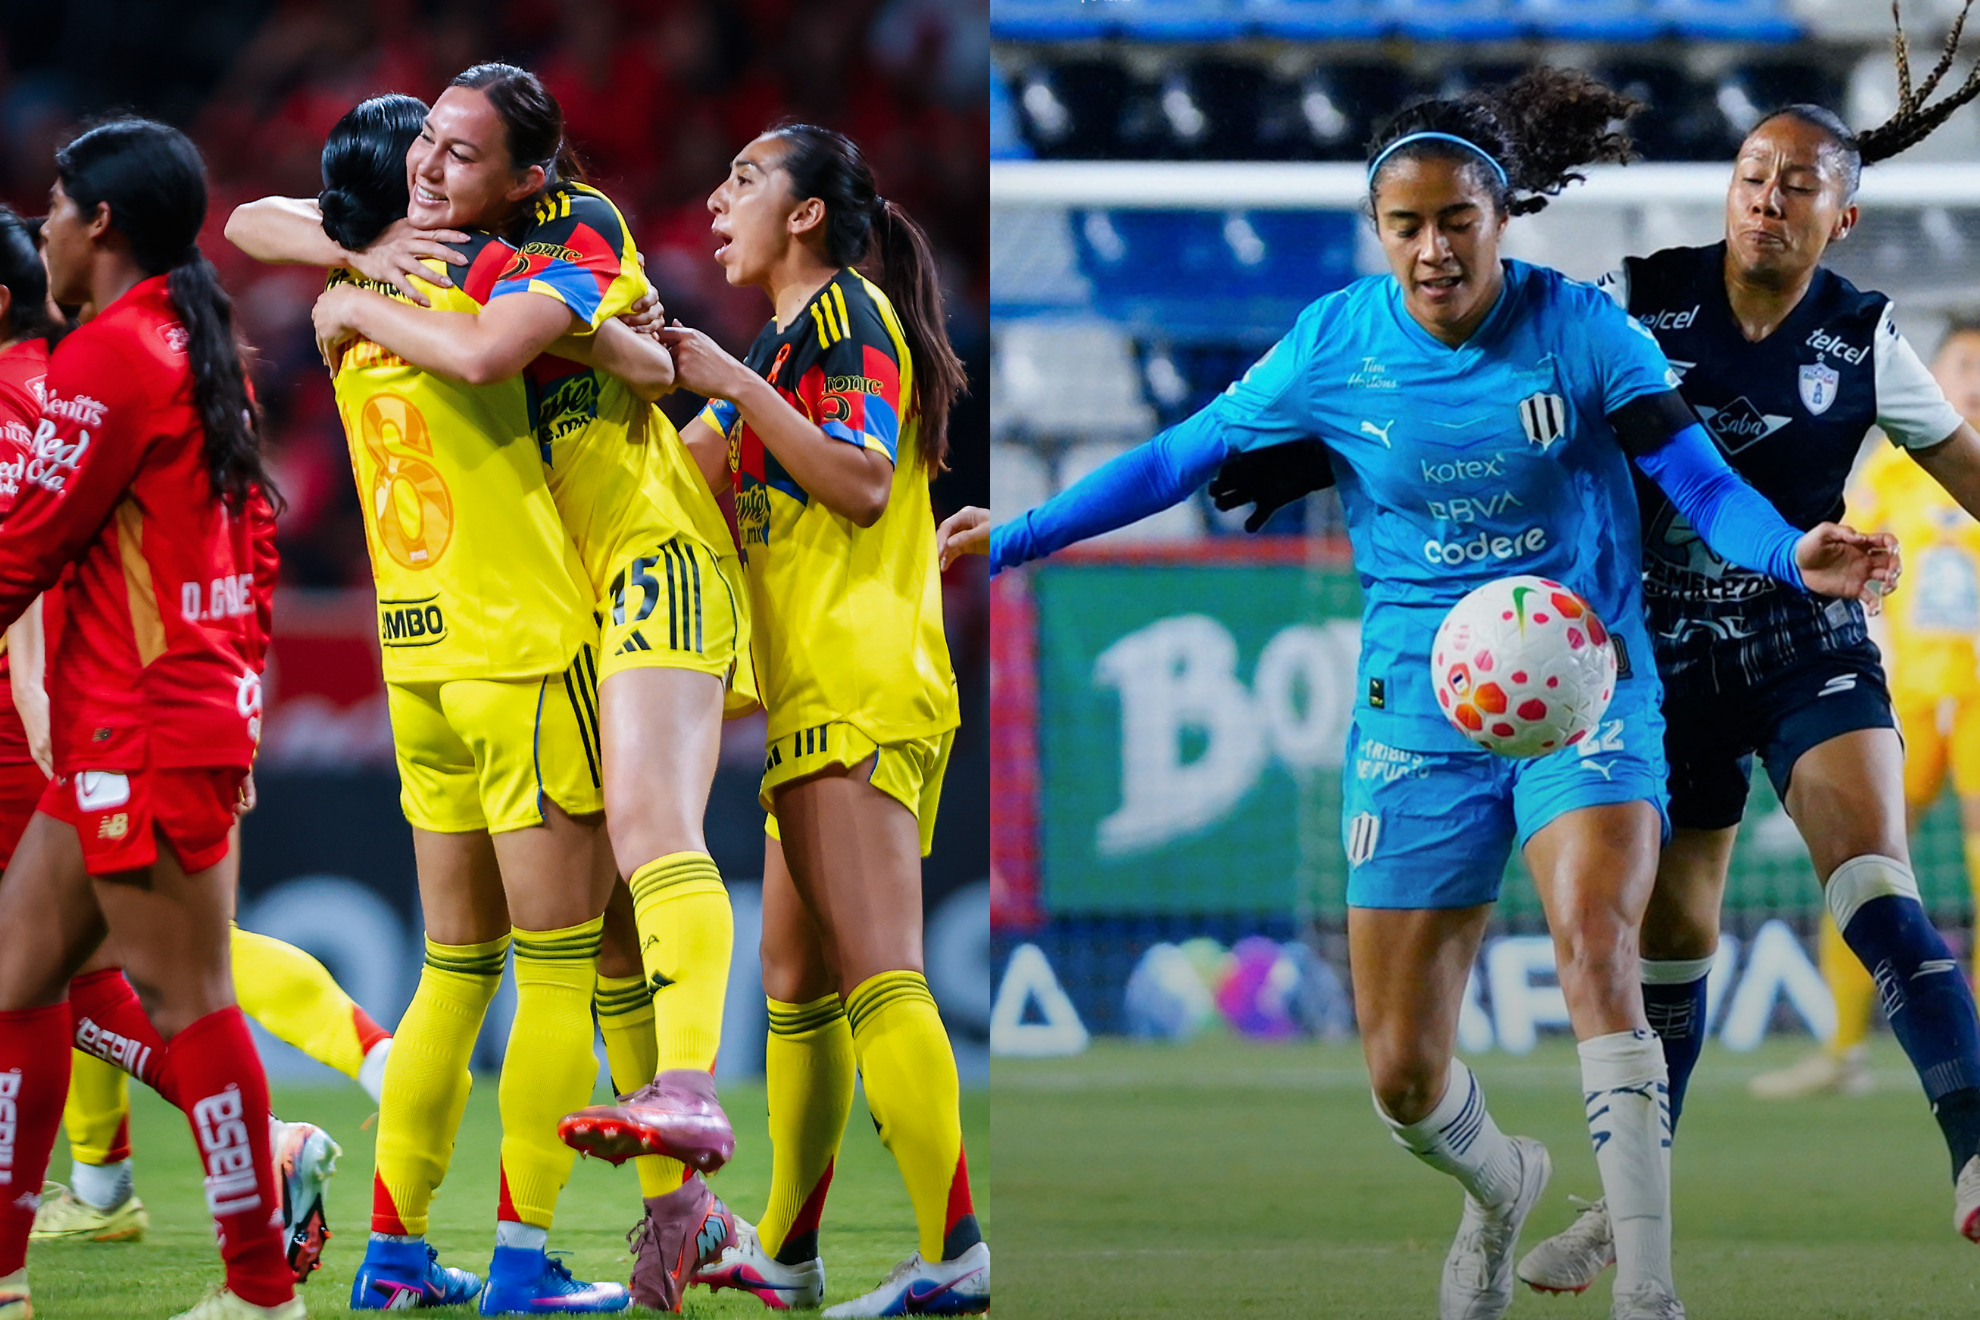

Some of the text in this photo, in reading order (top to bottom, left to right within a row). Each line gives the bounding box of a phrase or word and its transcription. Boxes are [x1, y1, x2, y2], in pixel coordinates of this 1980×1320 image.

[1805, 328, 1871, 366] telcel
[1346, 373, 1398, 389] Hortons
[1361, 356, 1385, 373] Tim
[42, 388, 103, 427] Venus
[1715, 411, 1763, 436] Saba
[31, 417, 91, 469] Red
[0, 452, 25, 480] ed
[1420, 455, 1504, 484] kotex
[0, 477, 20, 494] ola
[1426, 490, 1524, 523] BBVA
[1423, 527, 1547, 565] codere
[609, 554, 661, 627] 15
[382, 605, 443, 640] MBO
[1577, 718, 1625, 757] 22
